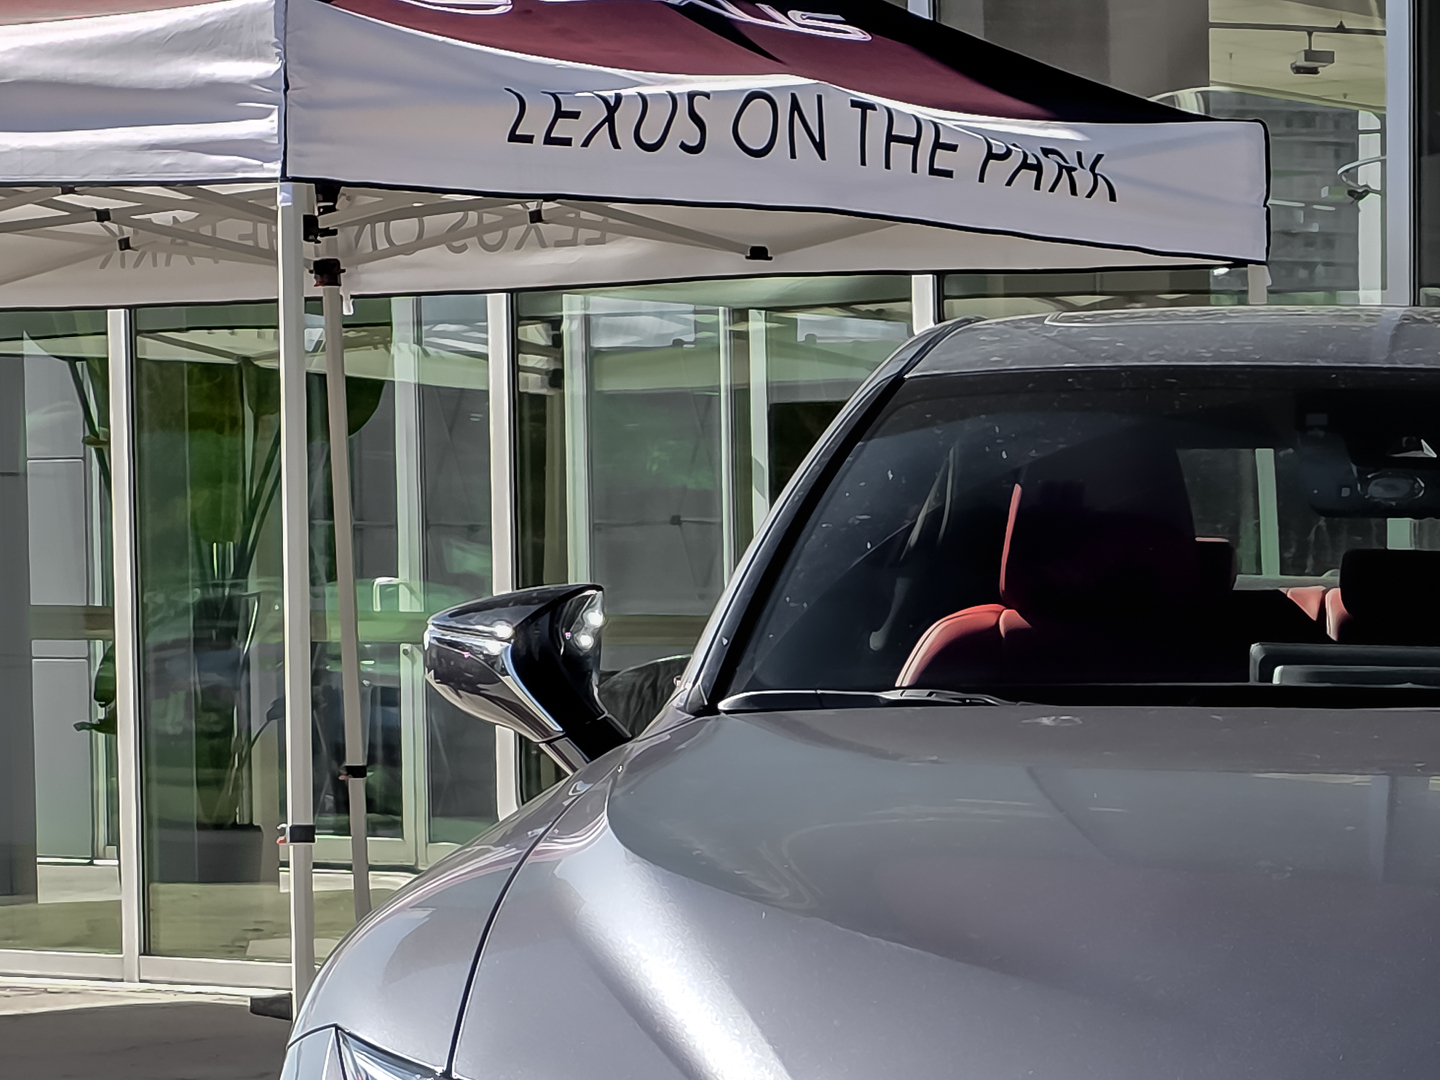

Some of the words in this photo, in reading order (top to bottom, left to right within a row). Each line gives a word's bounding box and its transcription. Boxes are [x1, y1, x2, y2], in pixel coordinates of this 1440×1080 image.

[503, 87, 712, 155] LEXUS
[732, 90, 826, 161] ON
[849, 98, 959, 179] THE
[978, 136, 1118, 203] PARK
